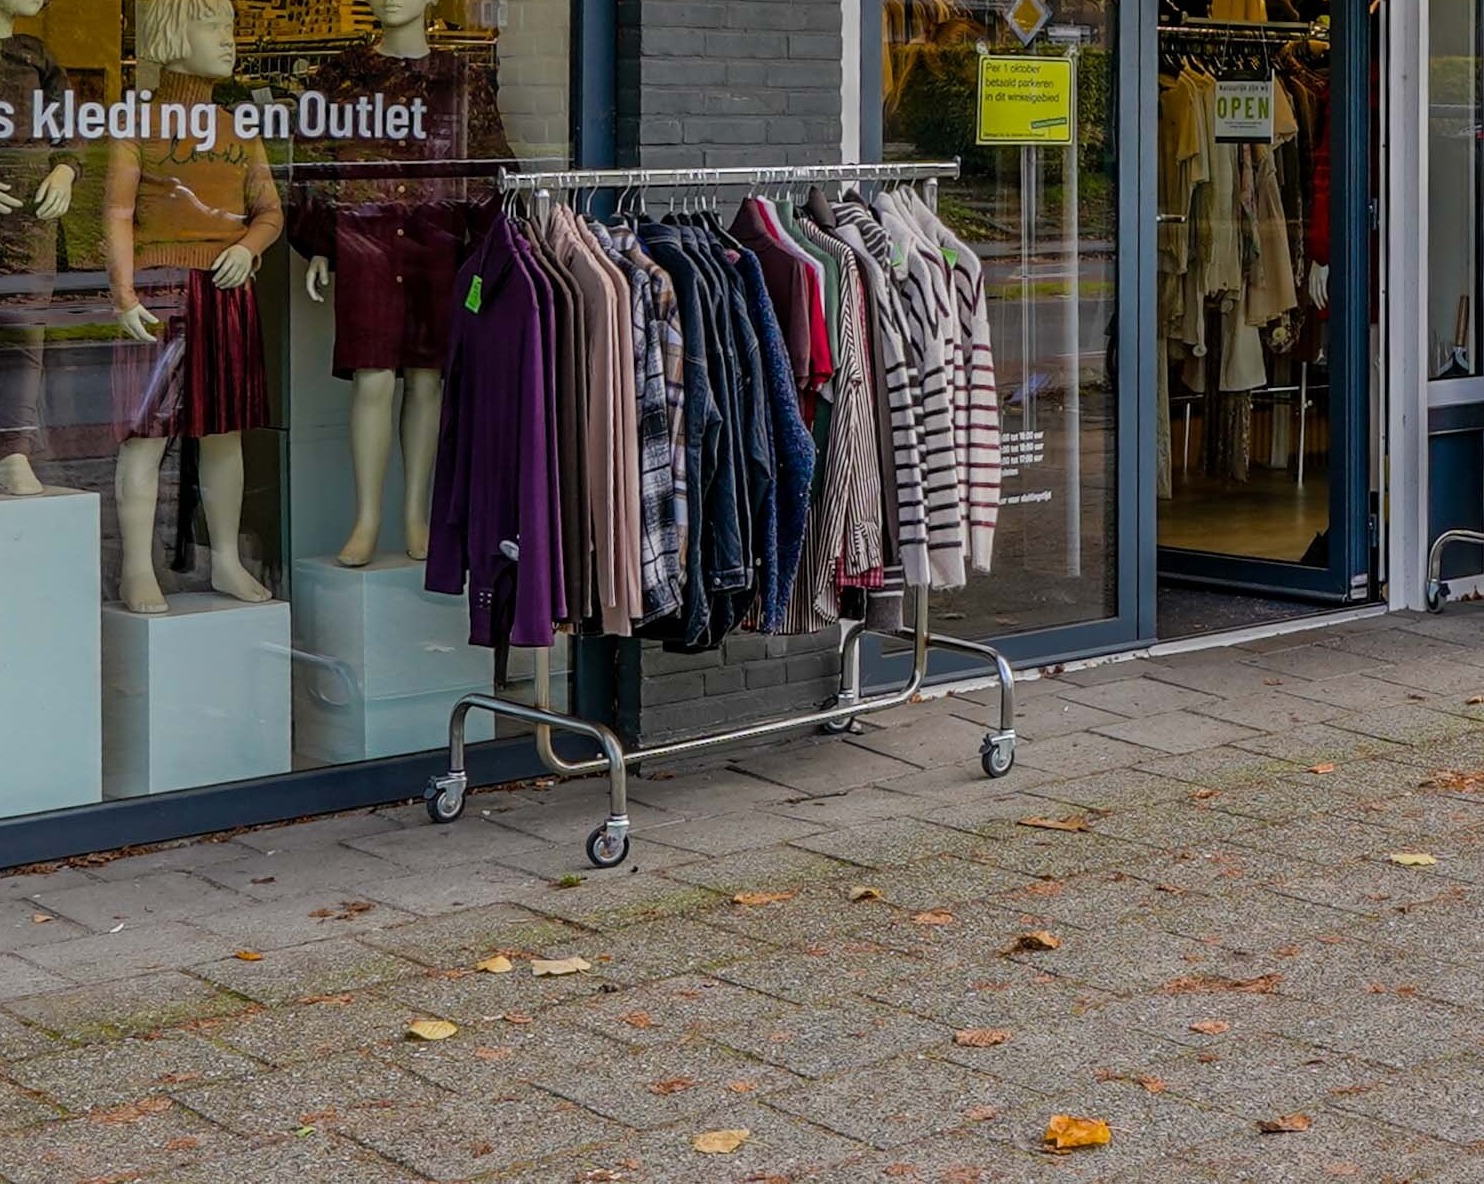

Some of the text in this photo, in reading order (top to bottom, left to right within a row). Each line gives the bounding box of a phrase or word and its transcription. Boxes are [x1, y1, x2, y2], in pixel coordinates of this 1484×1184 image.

[31, 87, 218, 152] kleding
[234, 99, 289, 140] en
[298, 94, 429, 141] Outlet
[1217, 96, 1269, 119] OPEN
